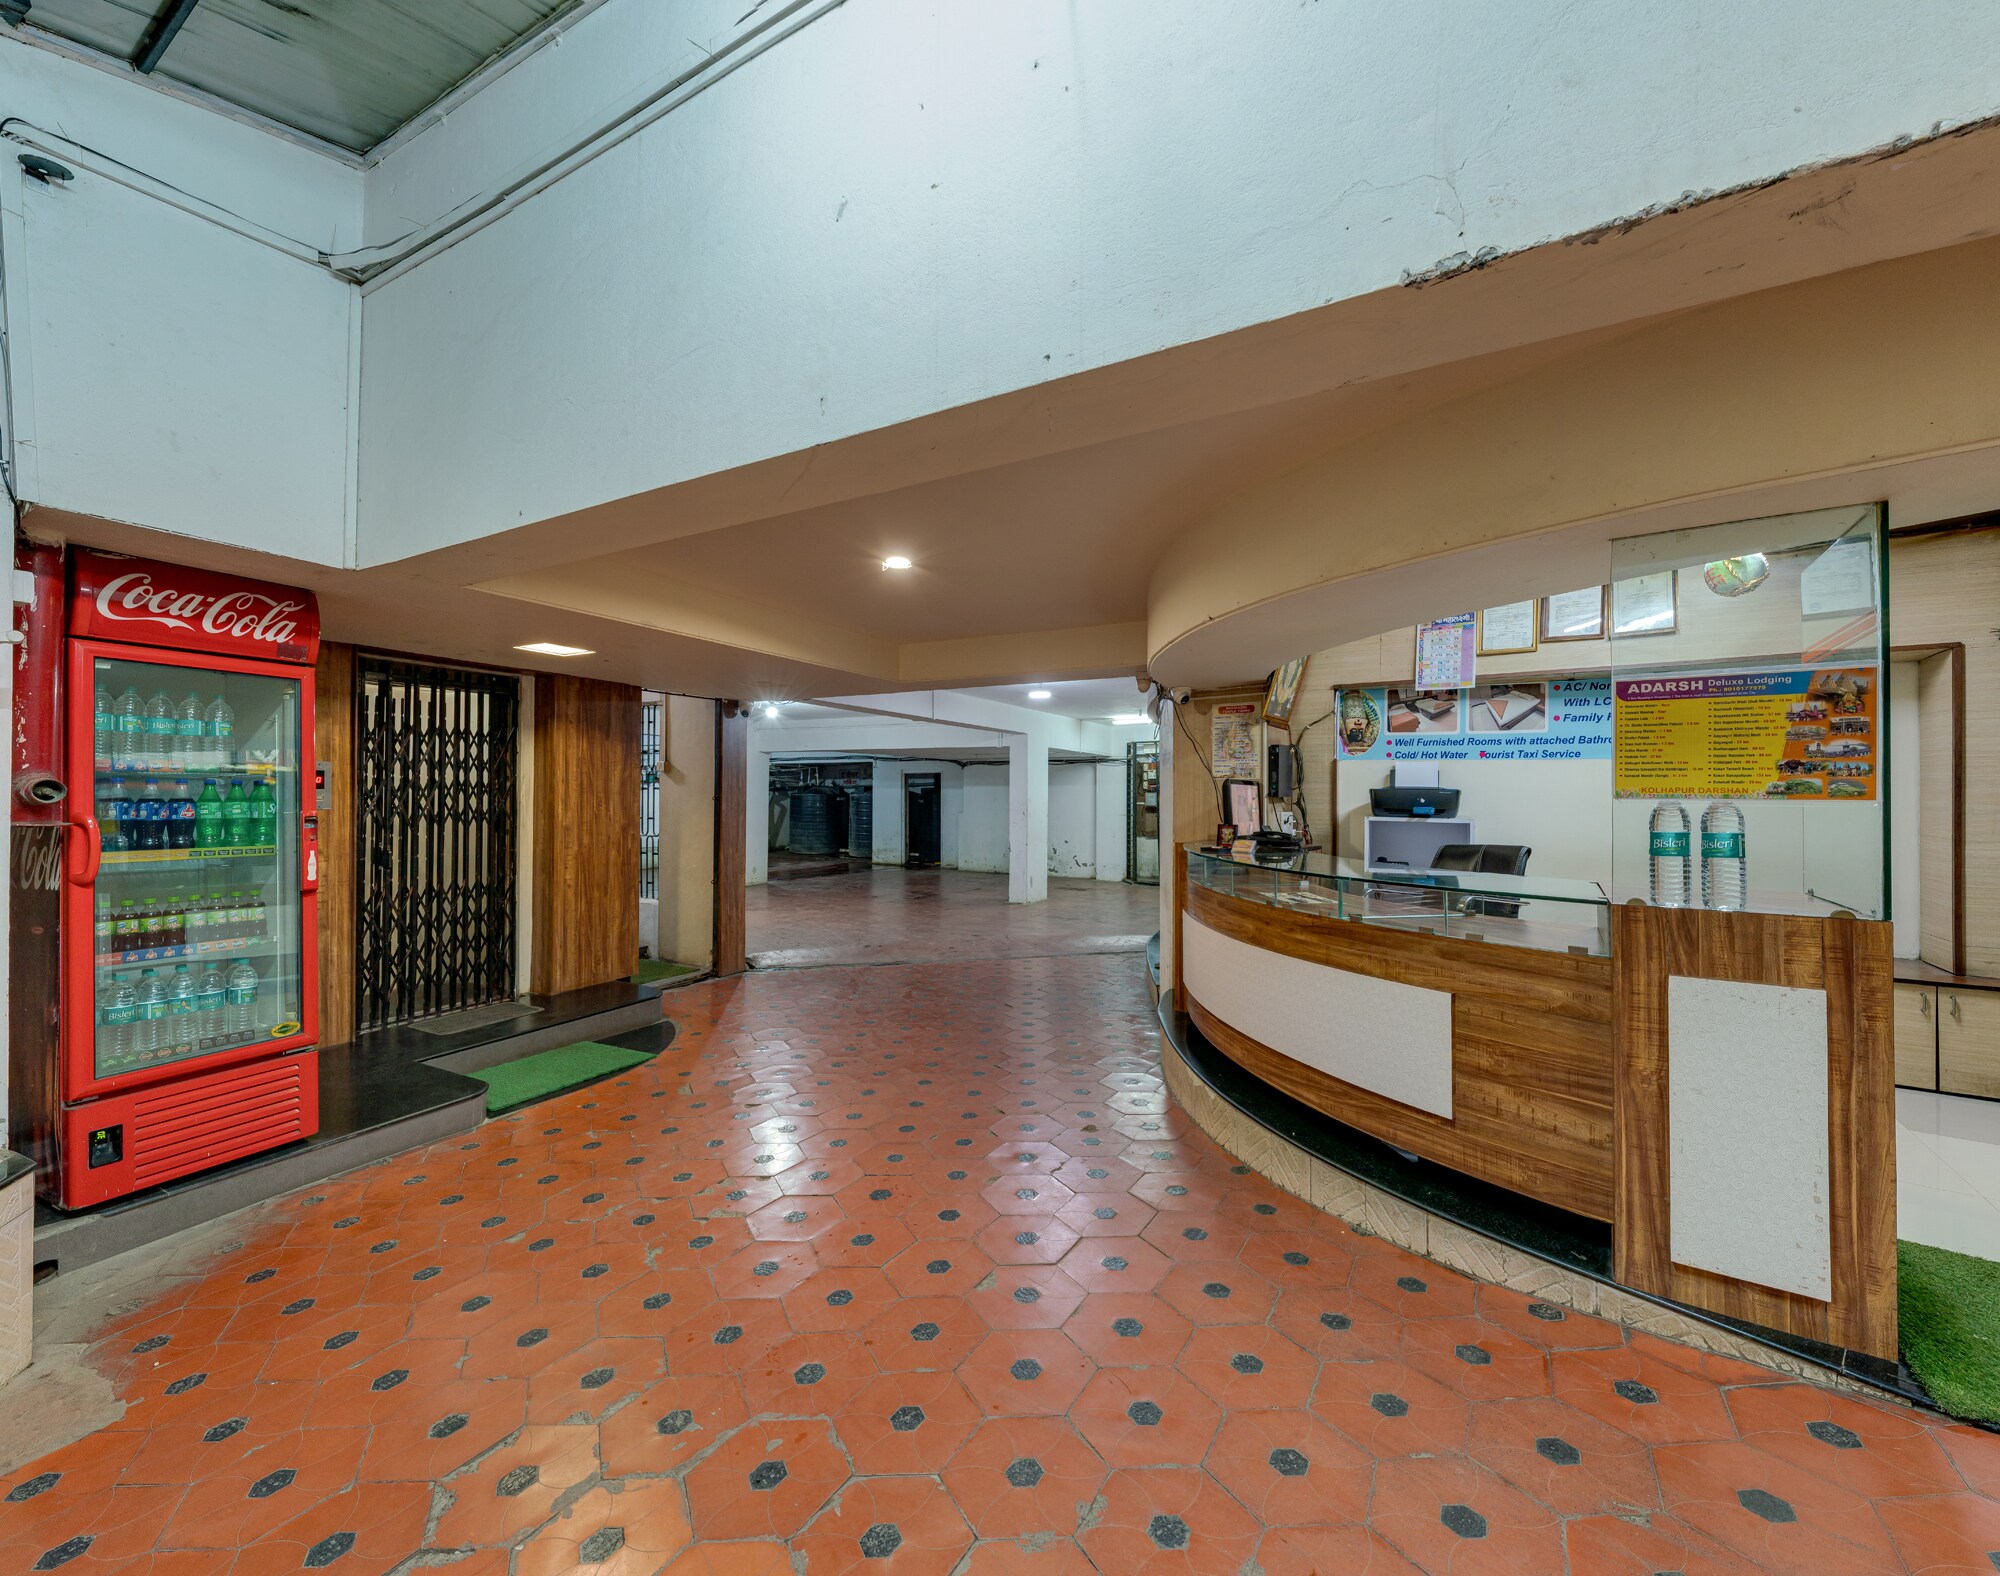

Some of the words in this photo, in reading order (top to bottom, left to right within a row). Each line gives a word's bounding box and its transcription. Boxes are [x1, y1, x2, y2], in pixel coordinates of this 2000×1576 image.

[96, 573, 305, 643] Coca-Cola
[1563, 682, 1588, 692] AC/
[1628, 680, 1703, 694] ADARSH
[1747, 676, 1792, 684] Lodging
[1564, 698, 1590, 706] With
[1563, 713, 1604, 724] Family
[1394, 738, 1414, 746] Well
[1416, 738, 1464, 746] Furnished
[1467, 737, 1502, 746] Rooms
[1505, 736, 1526, 745] with
[1529, 736, 1576, 744] attached
[1394, 750, 1419, 759] Cold/
[1420, 750, 1438, 758] Hot
[1440, 750, 1468, 758] Water
[1518, 750, 1538, 758] Taxi
[1541, 750, 1582, 758] Service
[1698, 786, 1749, 794] DARSHAN
[1653, 838, 1686, 848] Bisleri
[1702, 838, 1733, 849] Bisleri
[108, 1009, 136, 1021] Bisleri
